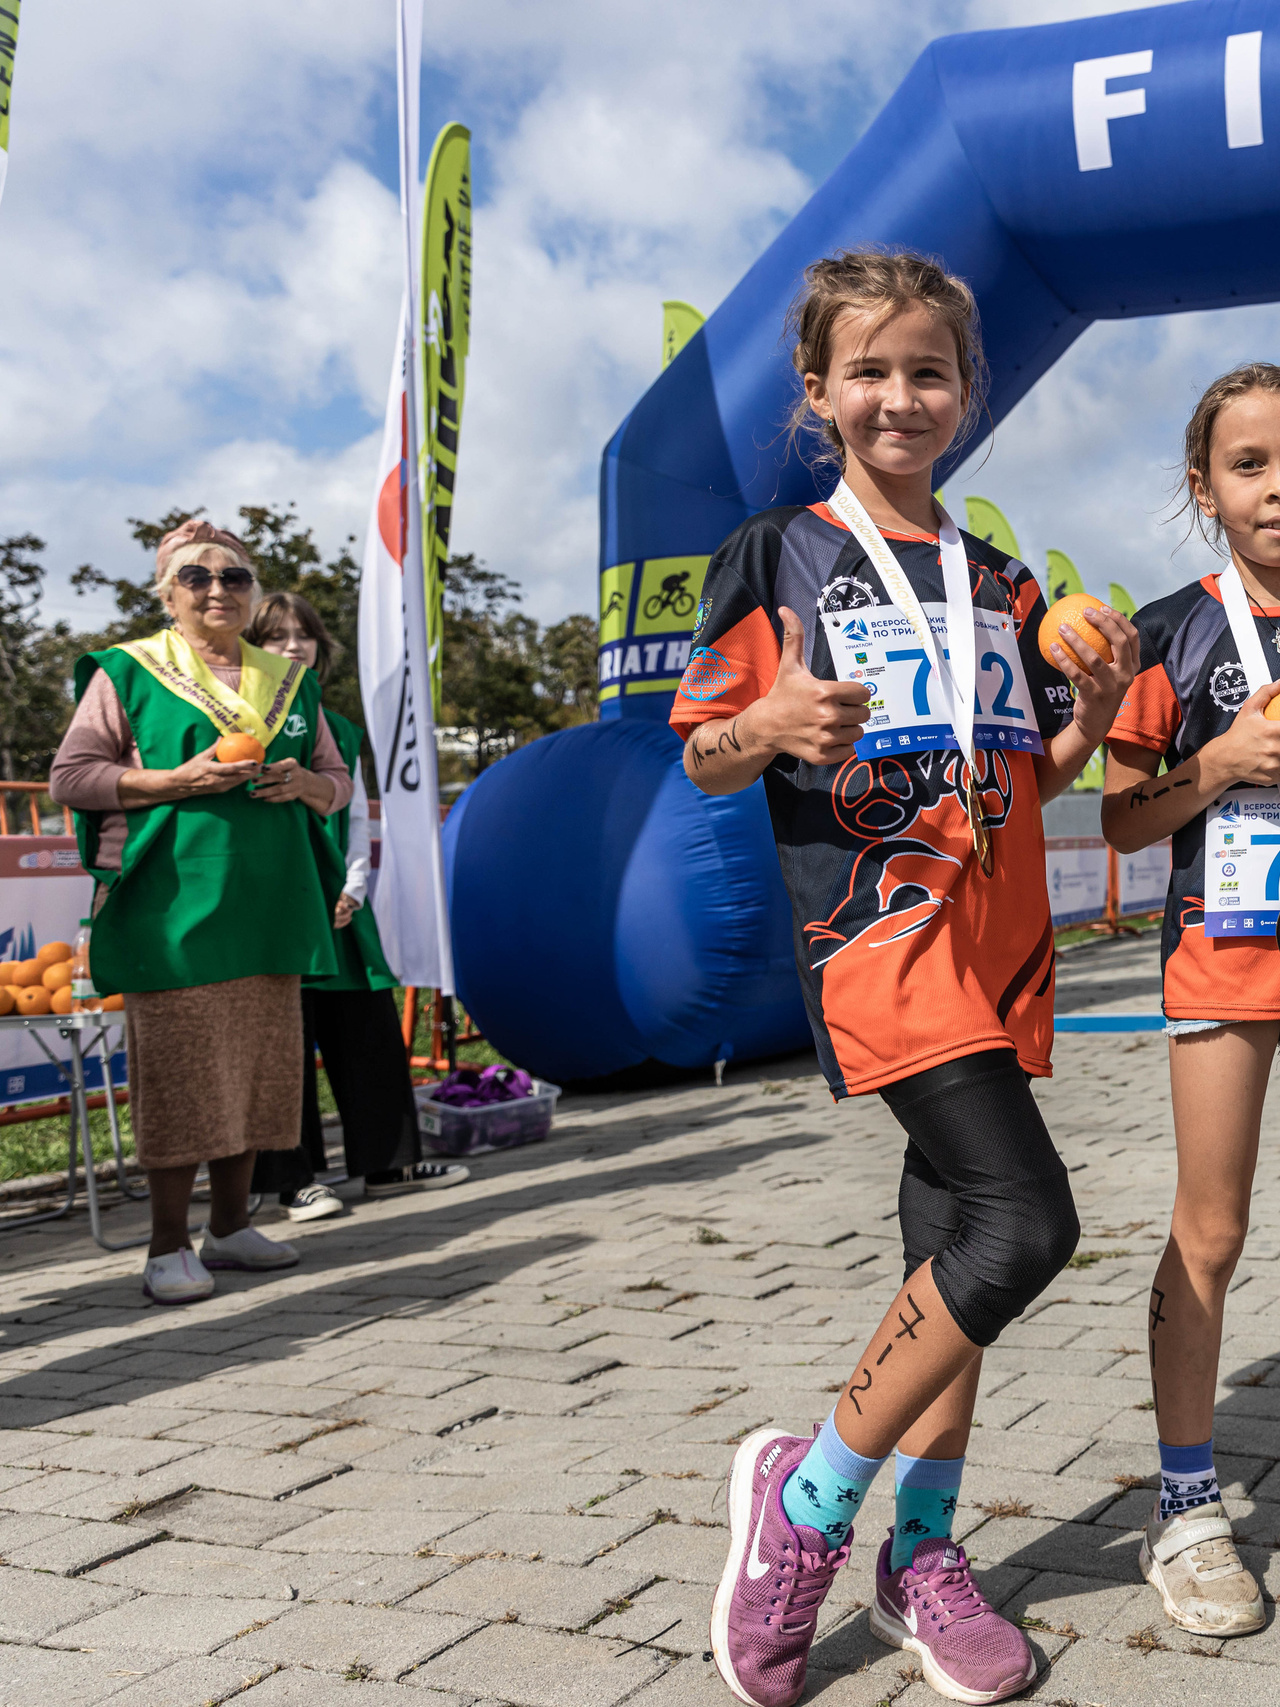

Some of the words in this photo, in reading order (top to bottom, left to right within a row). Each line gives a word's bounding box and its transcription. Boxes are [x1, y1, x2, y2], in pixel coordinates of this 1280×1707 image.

[837, 496, 891, 564] ПРИМОРСКОГО
[873, 629, 888, 638] ПО
[760, 1444, 782, 1478] NIKE
